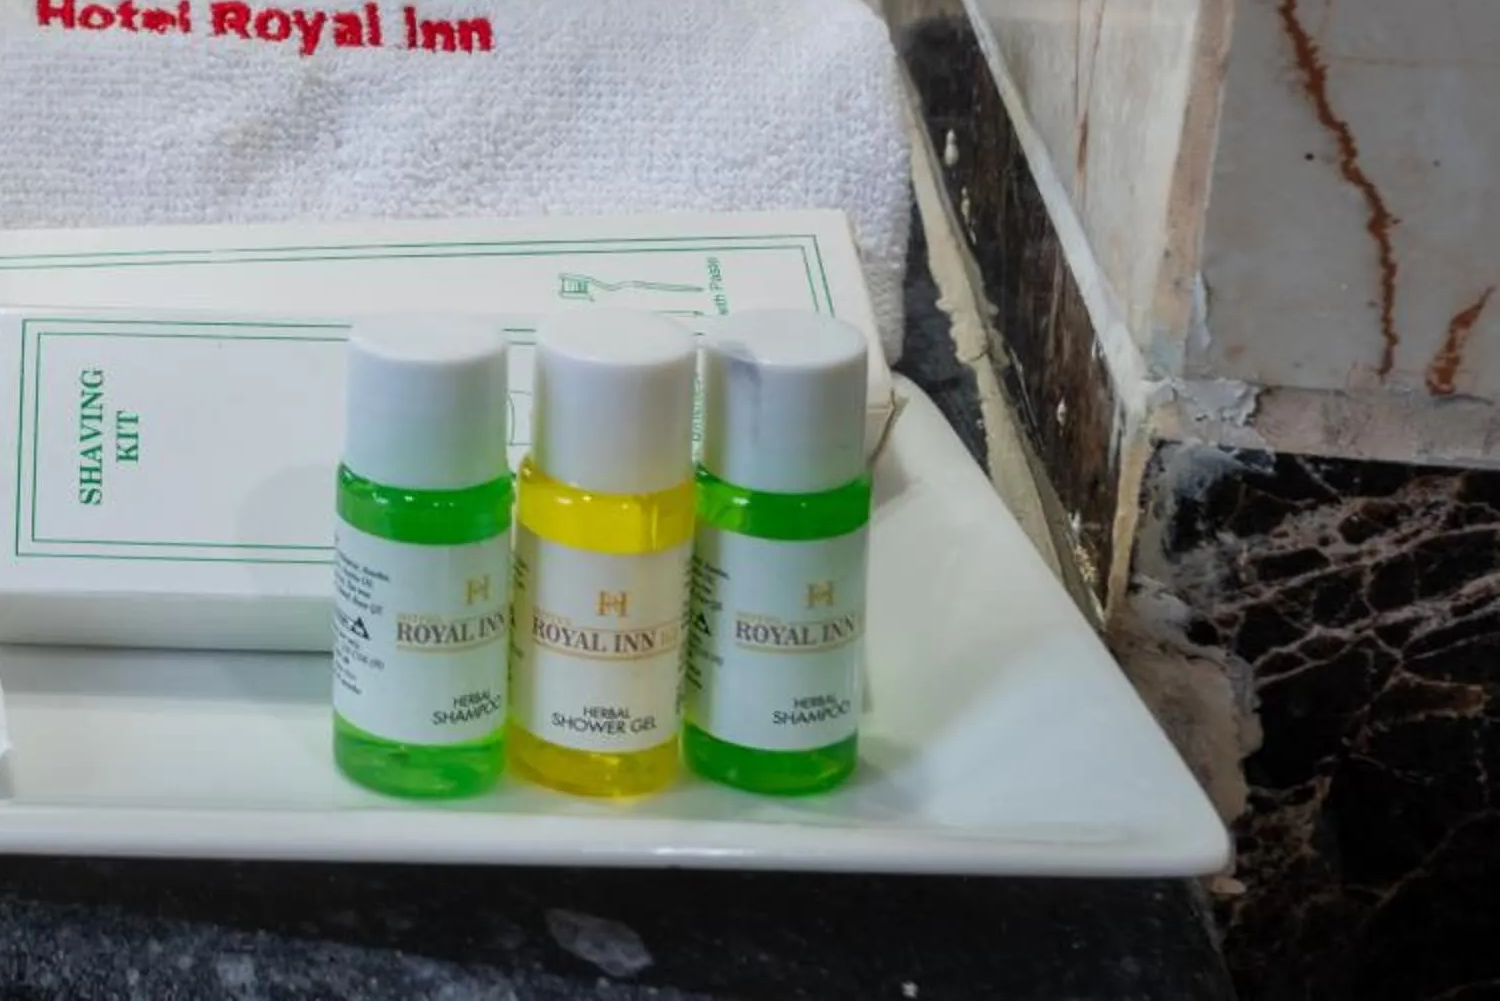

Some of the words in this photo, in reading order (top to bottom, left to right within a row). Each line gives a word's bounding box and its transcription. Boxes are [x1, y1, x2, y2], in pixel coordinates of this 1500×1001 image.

[207, 0, 384, 55] Royal
[403, 4, 494, 53] Inn
[79, 367, 104, 506] SHAVING
[116, 410, 140, 463] KIT
[397, 621, 475, 644] ROYAL
[532, 614, 607, 652] ROYAL
[614, 631, 656, 653] INN
[736, 620, 817, 646] ROYAL
[552, 712, 625, 734] SHOWER
[631, 716, 657, 733] GEL
[583, 706, 630, 719] HERBAL
